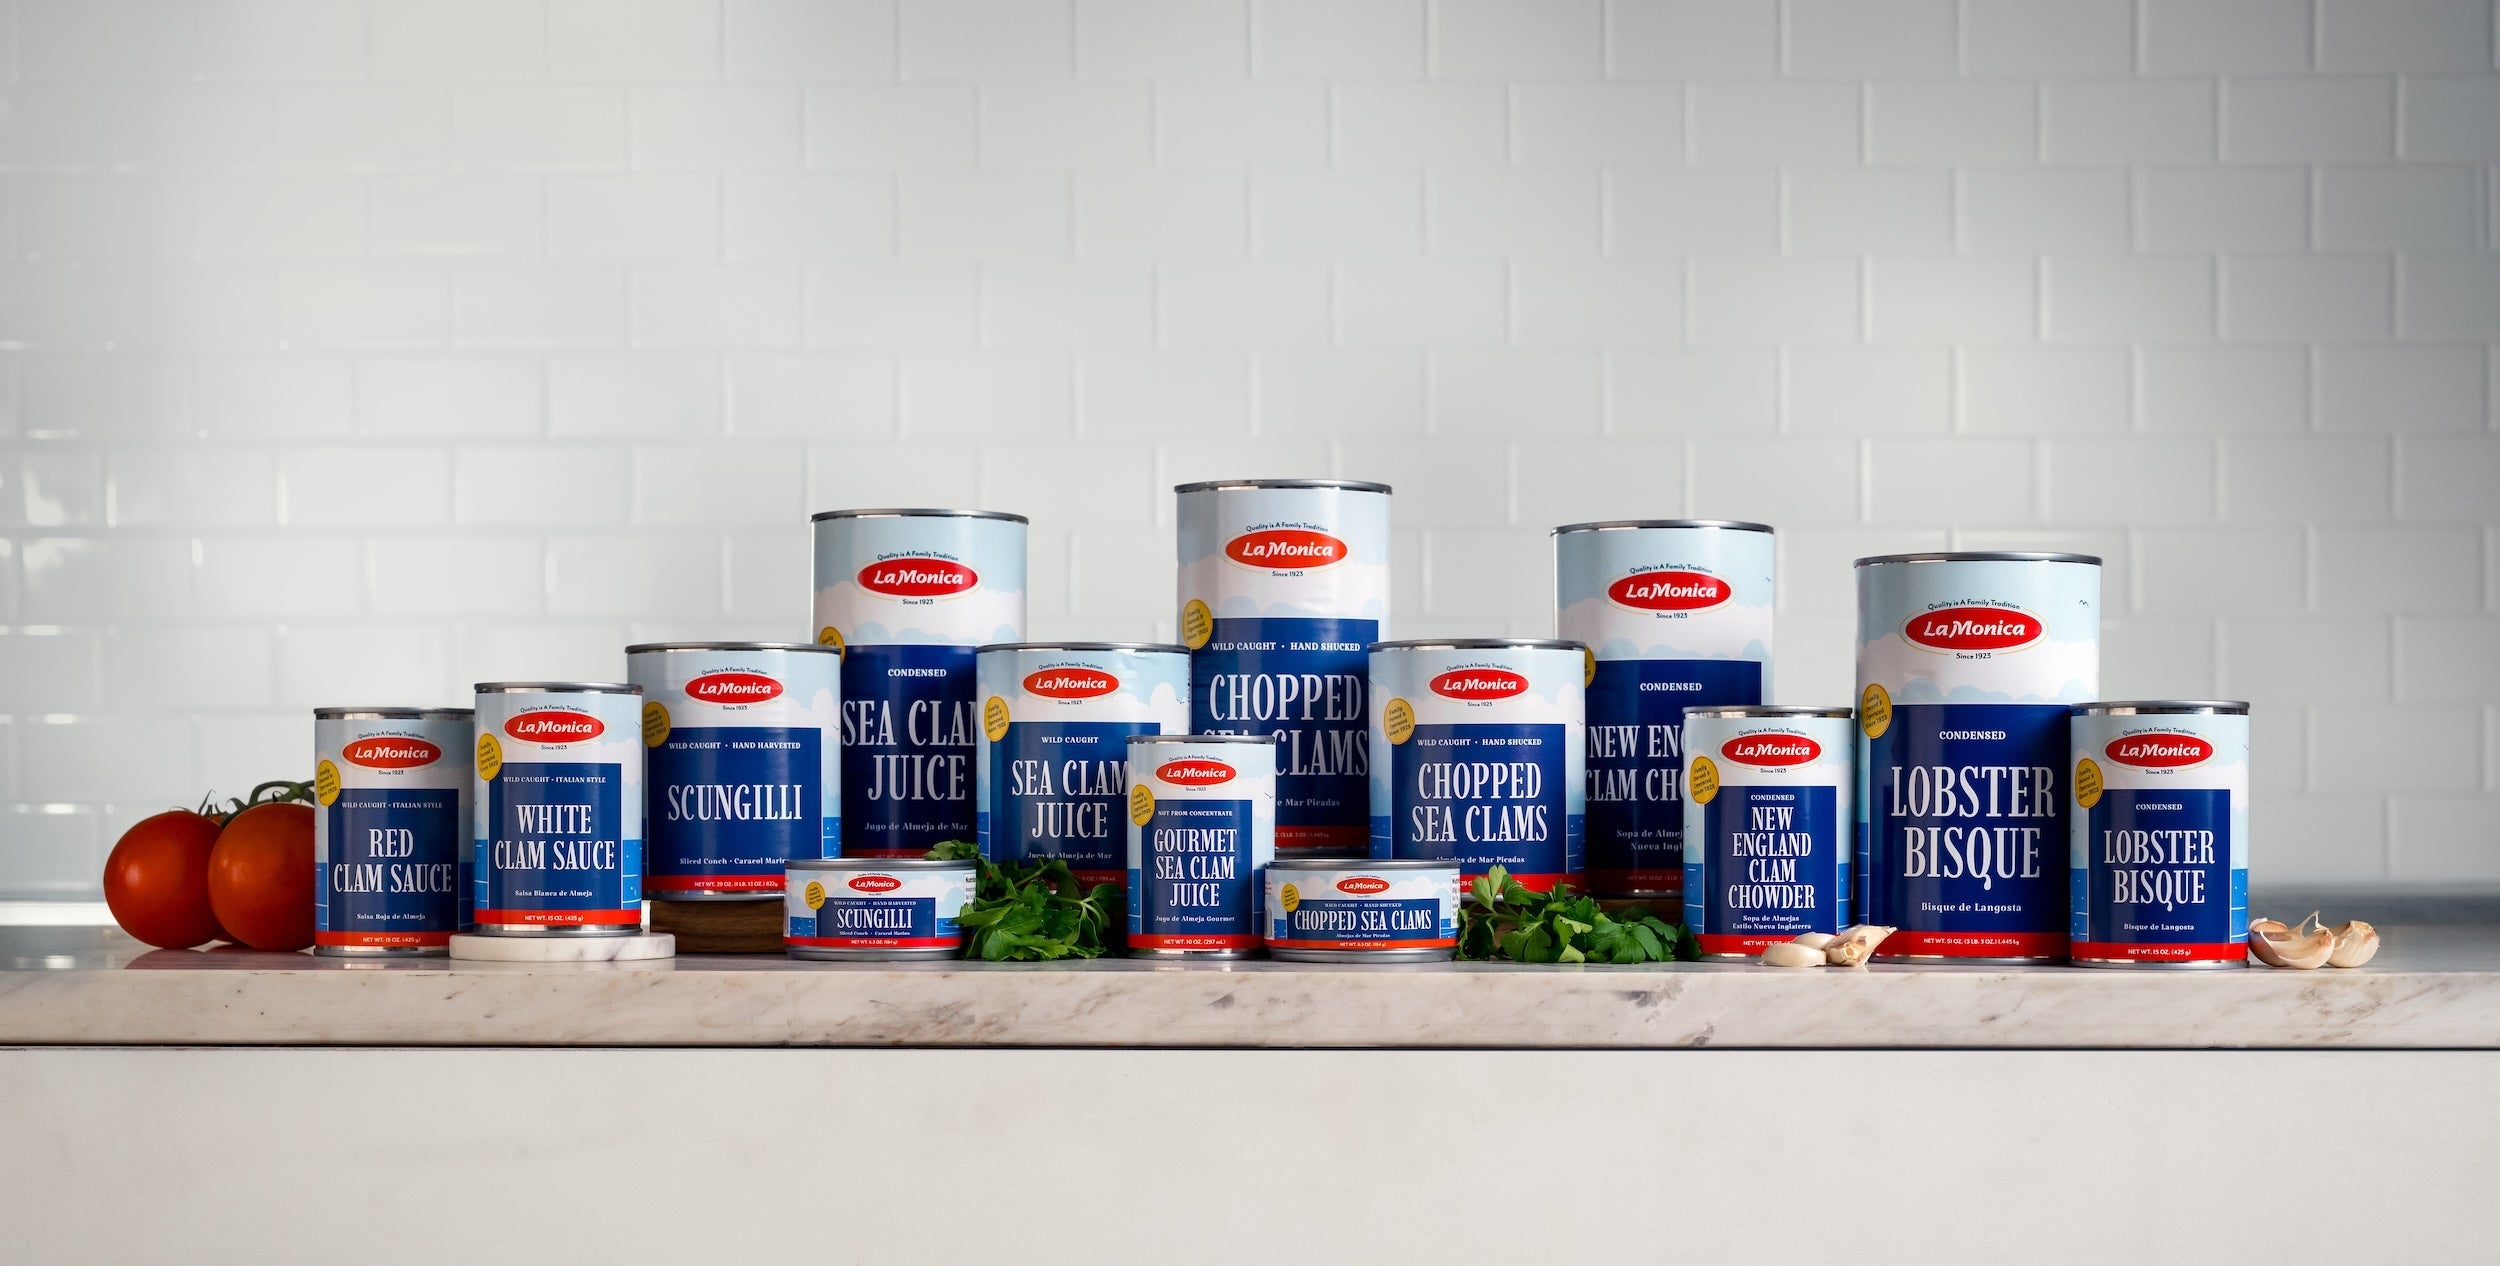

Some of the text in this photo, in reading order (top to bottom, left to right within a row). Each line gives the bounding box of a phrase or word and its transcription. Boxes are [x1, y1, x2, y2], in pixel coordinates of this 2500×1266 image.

[1242, 542, 1333, 558] LaMonica
[874, 570, 963, 586] LaMonica
[1626, 583, 1717, 600] LaMonica
[1928, 602, 1952, 610] Quality
[1967, 599, 1989, 607] Family
[1991, 600, 2019, 609] Tradition
[1924, 620, 2025, 638] LaMonica
[1236, 642, 1276, 650] CAUGHT
[1291, 642, 1318, 650] HAND
[1321, 643, 1360, 651] SHUCKED
[888, 669, 947, 677] CONDENSED
[1036, 678, 1107, 690] LaMonica
[1444, 678, 1517, 691] LaMonica
[699, 682, 771, 695] LaMonica
[1210, 674, 1361, 721] CHOPPED
[1640, 683, 1702, 691] CONDENSED
[517, 721, 592, 734] LaMonica
[842, 700, 897, 746] SEA
[1589, 725, 1640, 758] NEW
[1939, 731, 2006, 740] CONDENSED
[355, 746, 428, 760] LaMonica
[1735, 744, 1810, 757] LaMonica
[2119, 744, 2200, 758] LaMonica
[868, 755, 965, 800] JUICE
[1012, 760, 1128, 795] SEA CLAM
[1166, 768, 1226, 778] LaMonica
[1418, 763, 1541, 799] CHOPPED
[1585, 769, 1638, 801] CLAM
[1891, 766, 2056, 817] LOBSTER
[668, 784, 802, 820] SCUNGILLI
[516, 805, 591, 834] WHITE
[865, 822, 886, 831] Jugo
[889, 822, 899, 830] de
[902, 822, 935, 831] Almeja
[938, 822, 948, 830] de
[1032, 803, 1108, 838] JUICE
[1412, 805, 1548, 842] SEA CLAMS
[1752, 807, 1794, 830] NEW
[369, 829, 413, 857] RED
[1154, 829, 1237, 852] GOURMET
[1617, 830, 1638, 839] Sopa
[1732, 833, 1811, 857] ENGLAND
[495, 841, 614, 870] CLAM SAUCE
[2104, 830, 2215, 864] LOBSTER
[1156, 856, 1235, 879] SEA CLAM
[1904, 827, 2041, 891] BISQUE
[334, 864, 451, 893] CLAM SAUCE
[1749, 859, 1796, 883] CLAM
[1170, 883, 1219, 906] JUICE
[1728, 885, 1815, 908] CHOWDER
[2113, 870, 2205, 912] BISQUE
[838, 909, 912, 929] SCUNGILLI
[1922, 903, 2021, 913] Bisque de Langosta
[1295, 910, 1432, 931] CHOPPED SEA CLAMS
